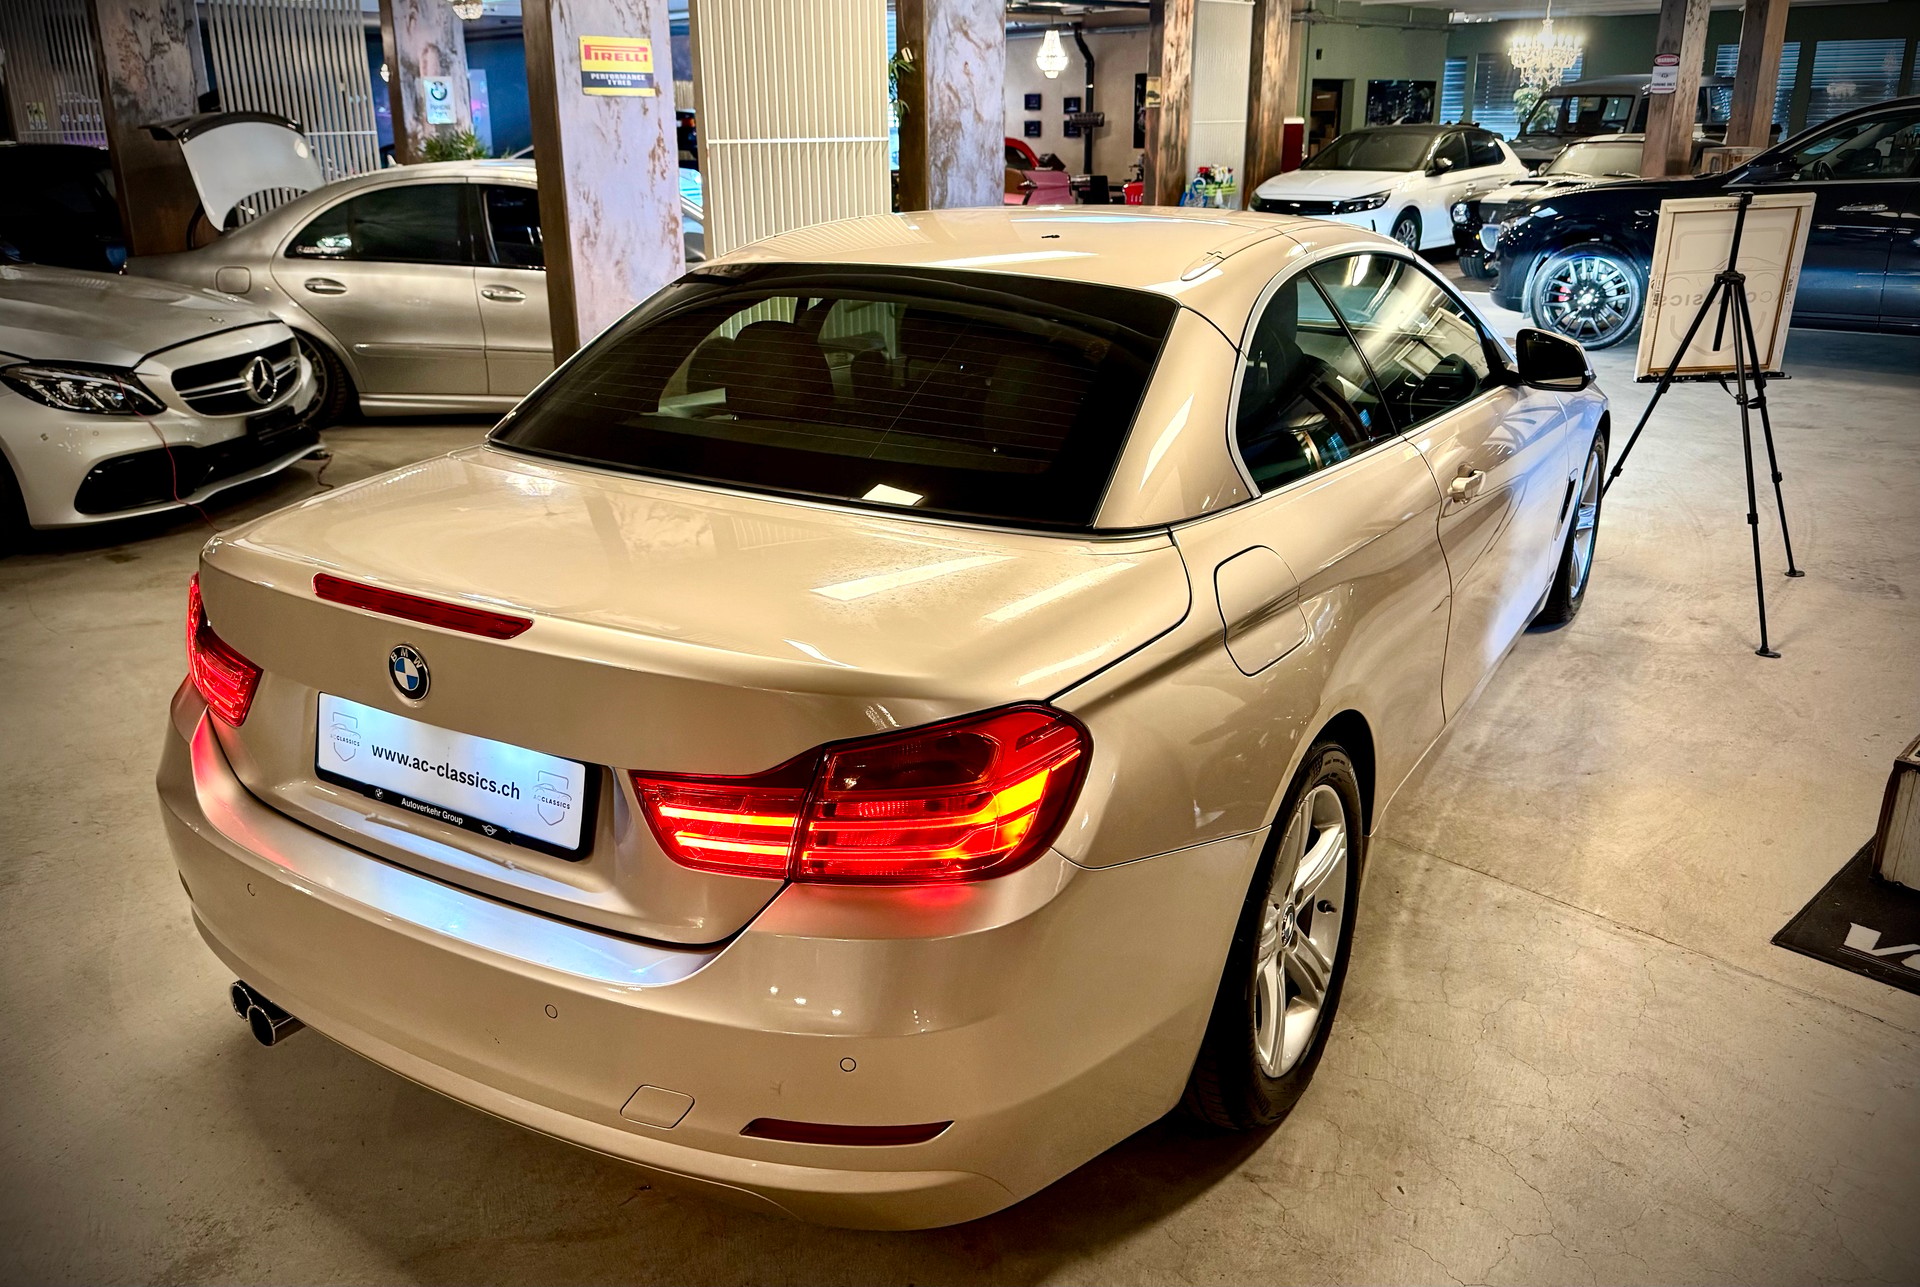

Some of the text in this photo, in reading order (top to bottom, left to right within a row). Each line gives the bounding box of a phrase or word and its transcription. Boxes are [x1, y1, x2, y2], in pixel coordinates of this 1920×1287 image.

[583, 44, 648, 62] PIRELLI
[590, 73, 646, 81] PERFORMANCE
[371, 744, 520, 800] www.ac-classics.ch
[401, 798, 464, 825] Autoverkehr Group
